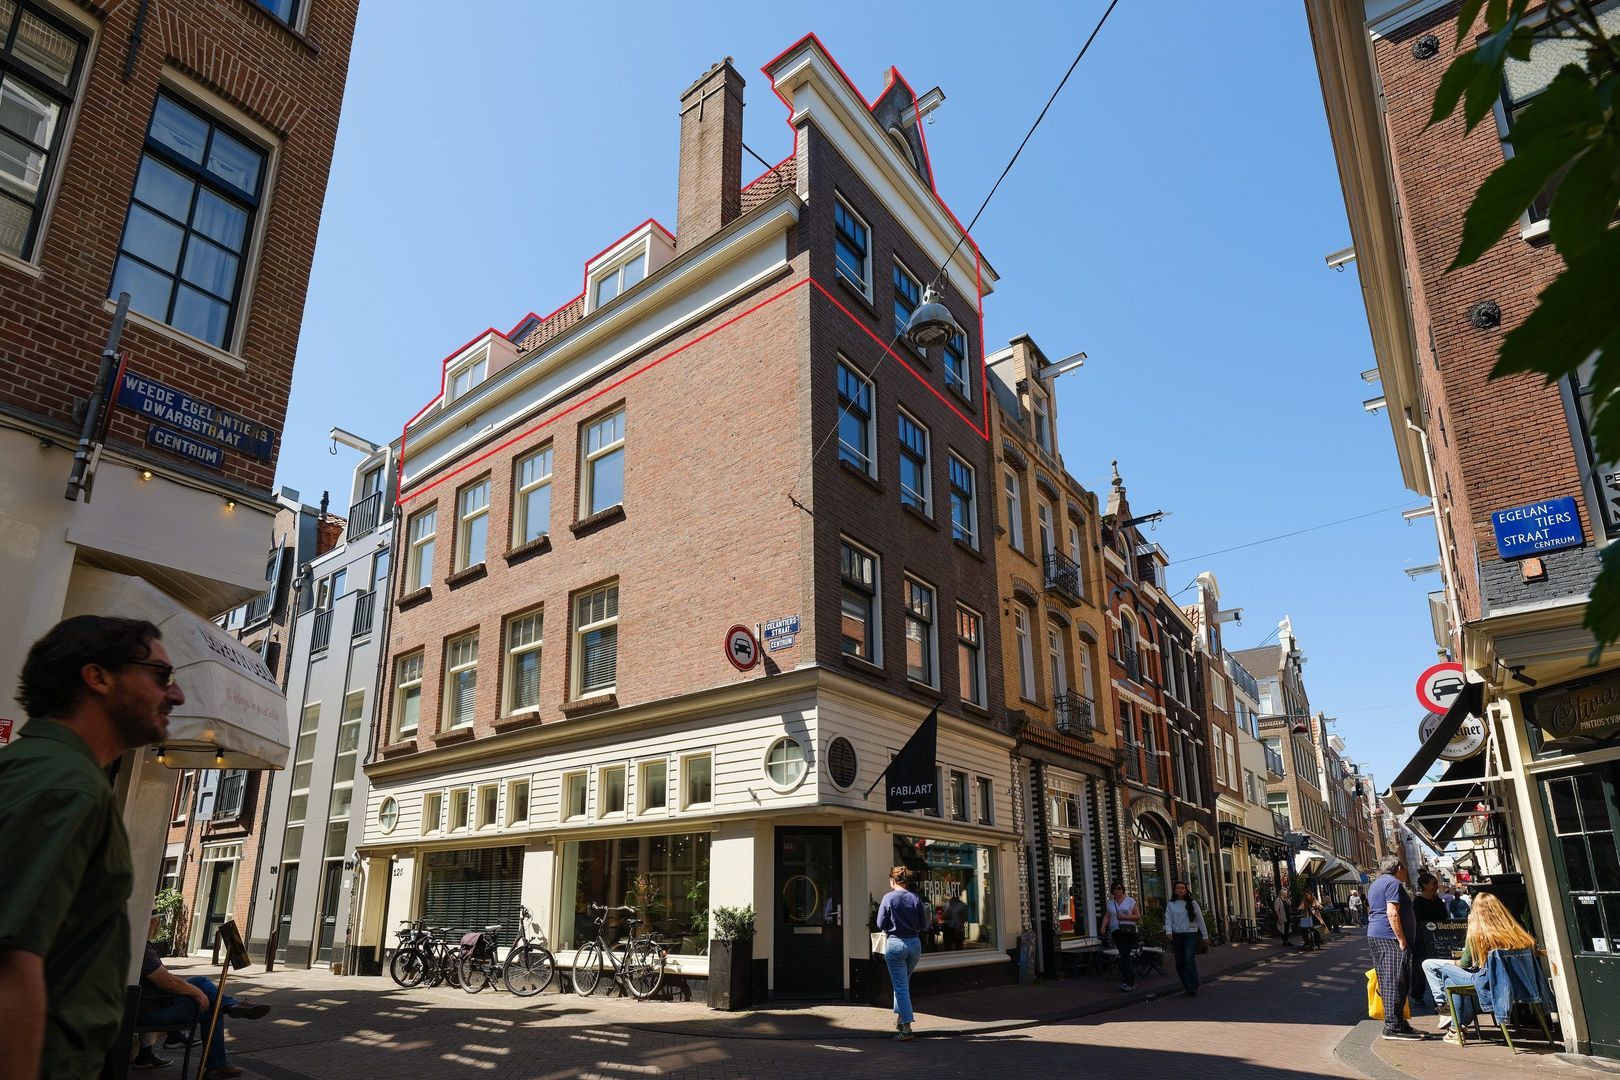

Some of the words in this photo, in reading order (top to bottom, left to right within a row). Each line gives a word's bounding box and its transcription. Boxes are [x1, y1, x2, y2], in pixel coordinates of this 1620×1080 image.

[123, 374, 175, 406] WEEDE
[181, 398, 268, 442] EGELANTIERS
[143, 399, 241, 446] DWARSSTRAAT
[155, 430, 217, 464] CENTRUM
[1499, 504, 1554, 523] EGELAN-
[1535, 512, 1571, 527] TIERS
[1504, 528, 1550, 546] STRAAT
[1534, 536, 1575, 549] CENTRUM
[764, 617, 797, 631] EGELANTIERS
[771, 637, 793, 648] CENTRUM
[1580, 718, 1605, 730] PINTXOS
[890, 784, 933, 797] FABI.ART
[924, 880, 961, 898] FABI.ART
